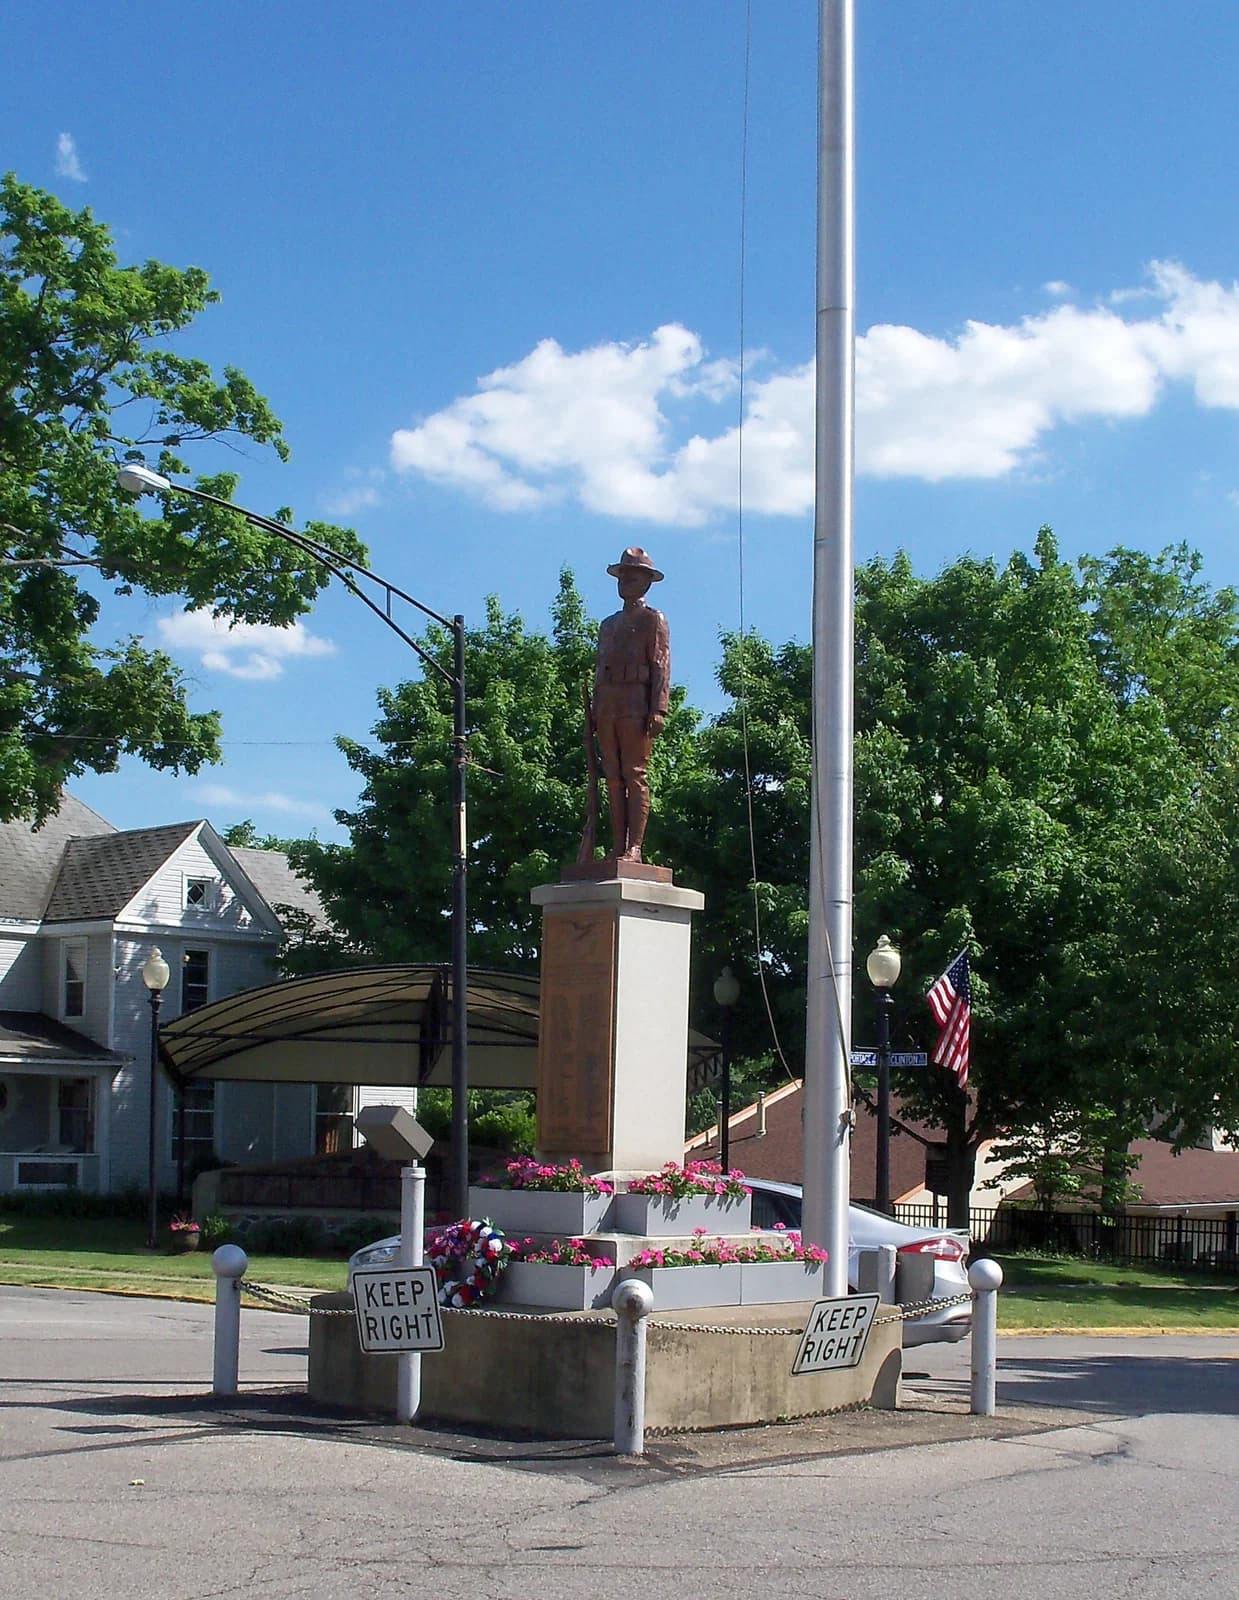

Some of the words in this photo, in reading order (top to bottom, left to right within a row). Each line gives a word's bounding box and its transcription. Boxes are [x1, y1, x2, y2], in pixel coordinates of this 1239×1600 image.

[890, 1055, 918, 1065] CLINTON
[365, 1280, 424, 1307] KEEP
[365, 1314, 432, 1341] RIGHT
[813, 1306, 867, 1333] KEEP
[801, 1335, 862, 1364] RIGHT
